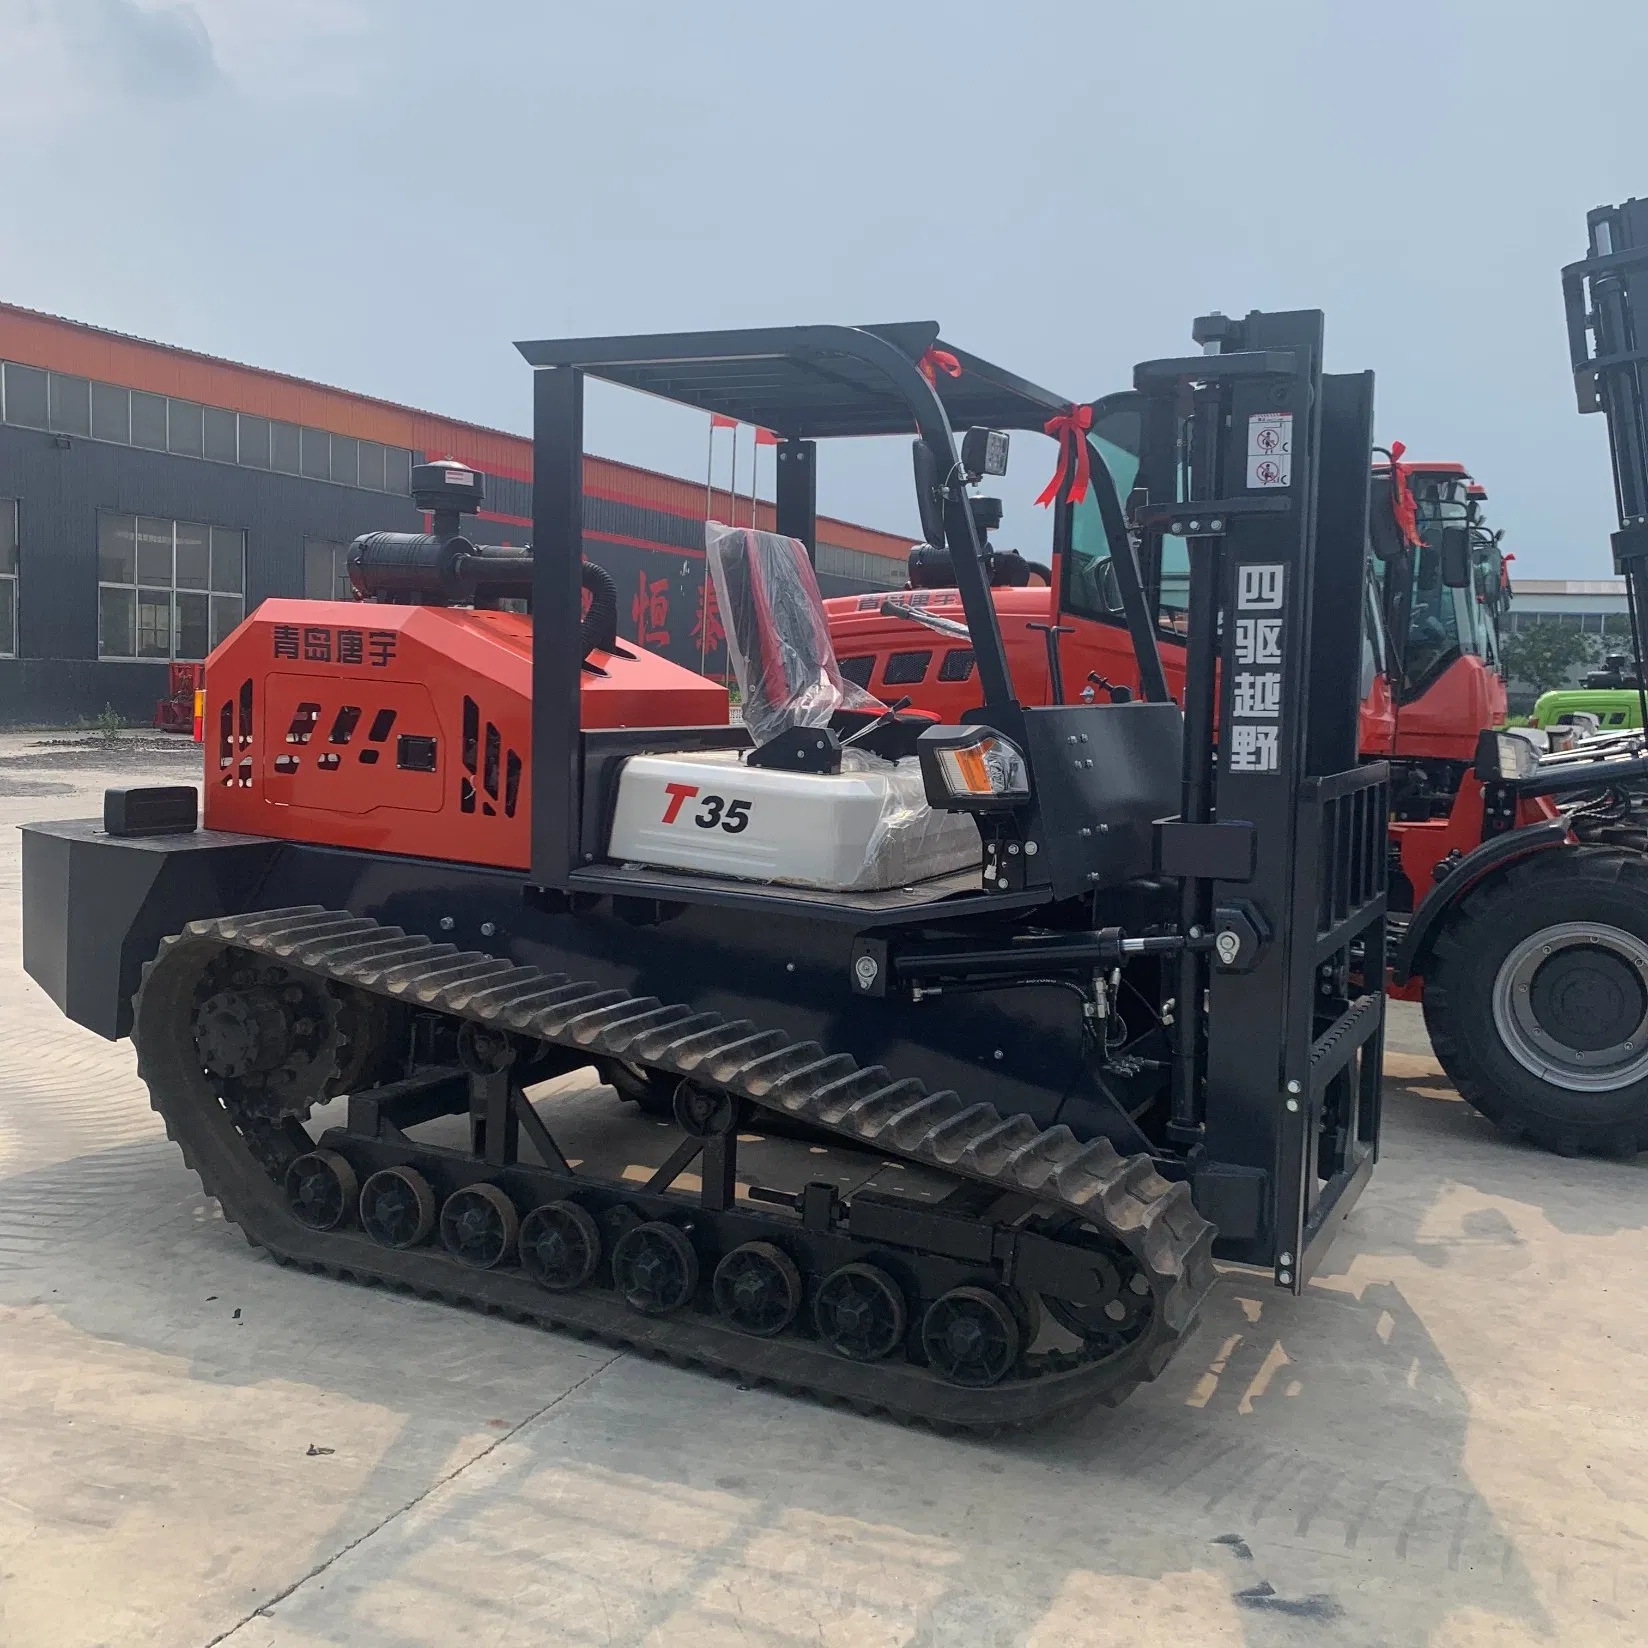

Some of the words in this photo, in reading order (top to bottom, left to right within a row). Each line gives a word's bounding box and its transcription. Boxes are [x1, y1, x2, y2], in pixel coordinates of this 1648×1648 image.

[274, 625, 396, 666] 青岛唐宇
[1230, 565, 1283, 770] 四驱越野
